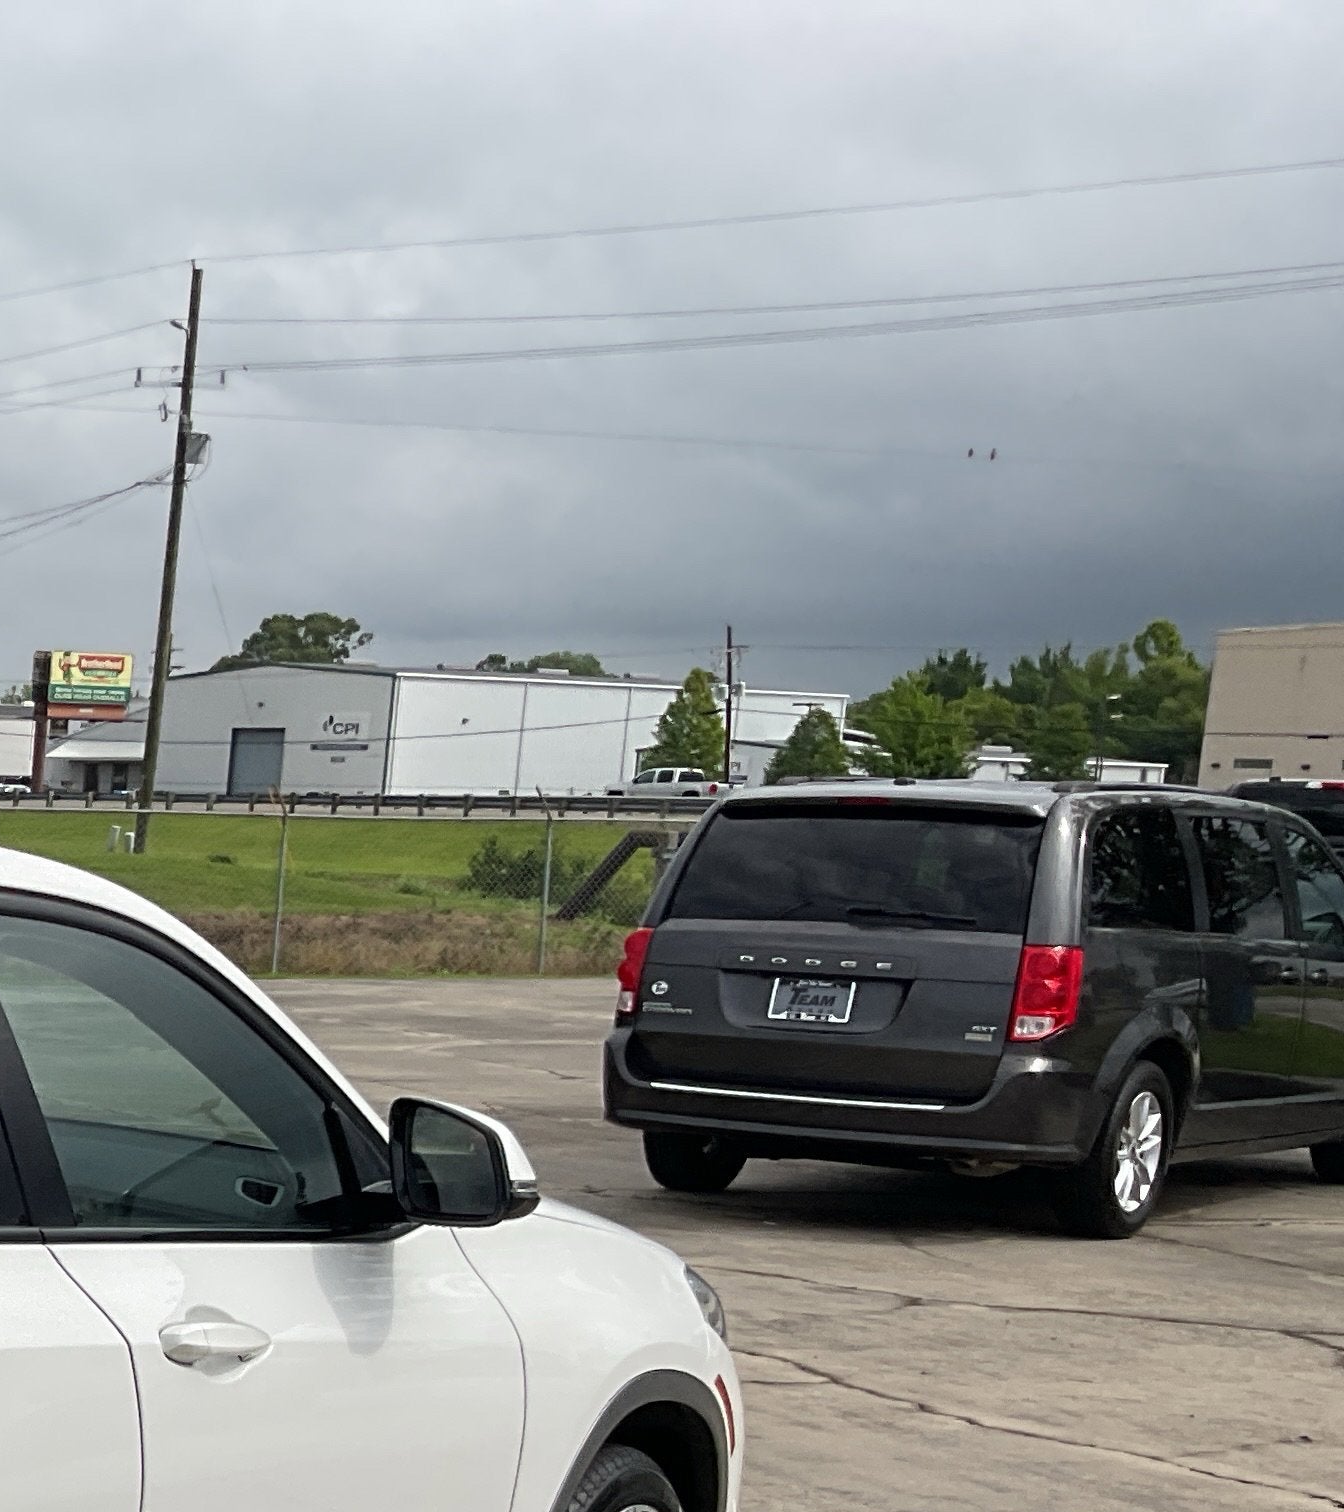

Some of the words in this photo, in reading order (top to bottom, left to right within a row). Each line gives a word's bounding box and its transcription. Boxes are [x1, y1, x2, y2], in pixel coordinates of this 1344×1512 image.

[332, 722, 360, 735] CPI
[739, 954, 893, 971] DODGE
[788, 986, 837, 1007] TEAM
